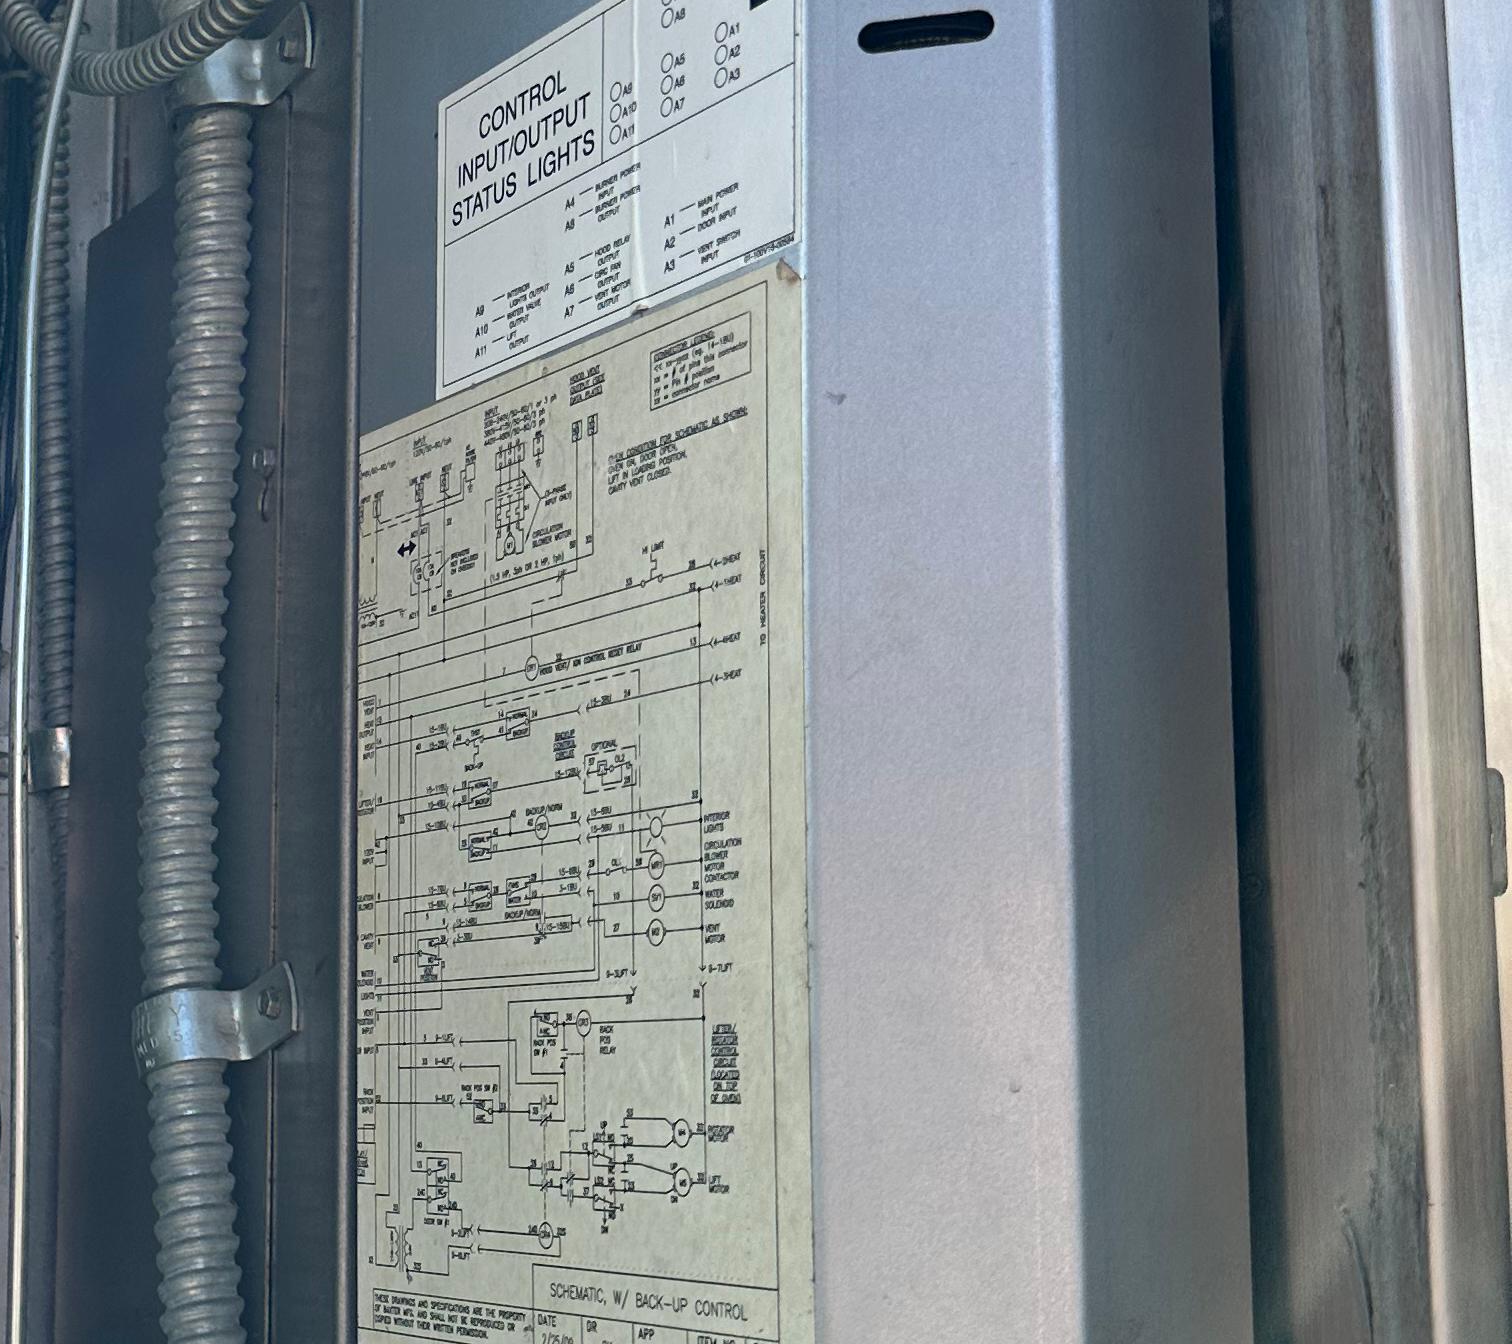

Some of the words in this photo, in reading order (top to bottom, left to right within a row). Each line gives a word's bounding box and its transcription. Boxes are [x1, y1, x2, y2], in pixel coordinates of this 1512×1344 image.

[728, 20, 739, 39] A1
[674, 51, 685, 69] A5
[728, 43, 740, 61] A2
[728, 66, 740, 84] A3
[622, 80, 632, 98] A9
[479, 65, 566, 141] CONTROL
[622, 100, 637, 119] A10
[674, 95, 685, 113] A7
[457, 90, 591, 190] INPUT/OUTPUT
[622, 123, 634, 141] A11
[451, 170, 516, 228] STATUS
[527, 126, 595, 188] LIGHTS
[549, 1281, 607, 1305] SCHEMATIC,
[612, 1287, 629, 1310] W/
[635, 1291, 688, 1315] BACK-UP
[694, 1298, 748, 1323] CONTROL
[537, 1313, 556, 1327] DATE
[637, 1326, 654, 1341] APP
